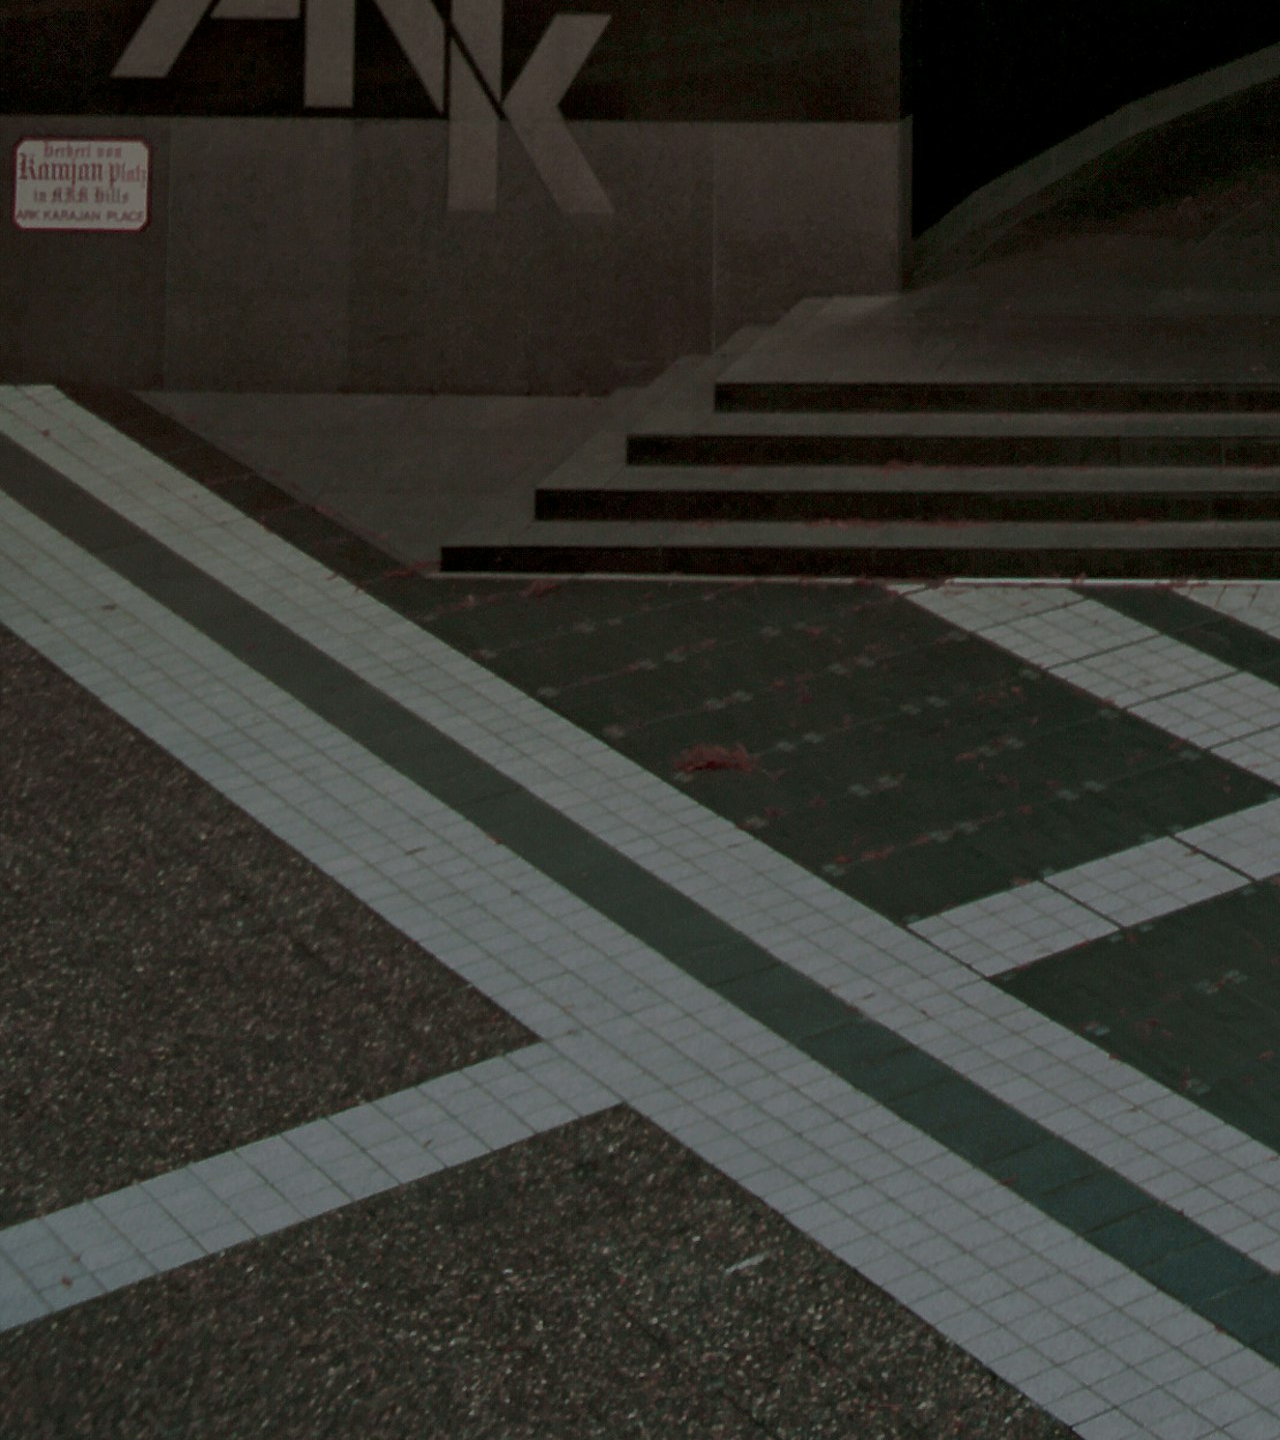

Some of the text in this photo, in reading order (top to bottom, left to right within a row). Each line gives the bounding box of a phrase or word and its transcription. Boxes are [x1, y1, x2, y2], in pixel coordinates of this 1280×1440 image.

[15, 209, 145, 223] ARK KARAJAN PLACE
